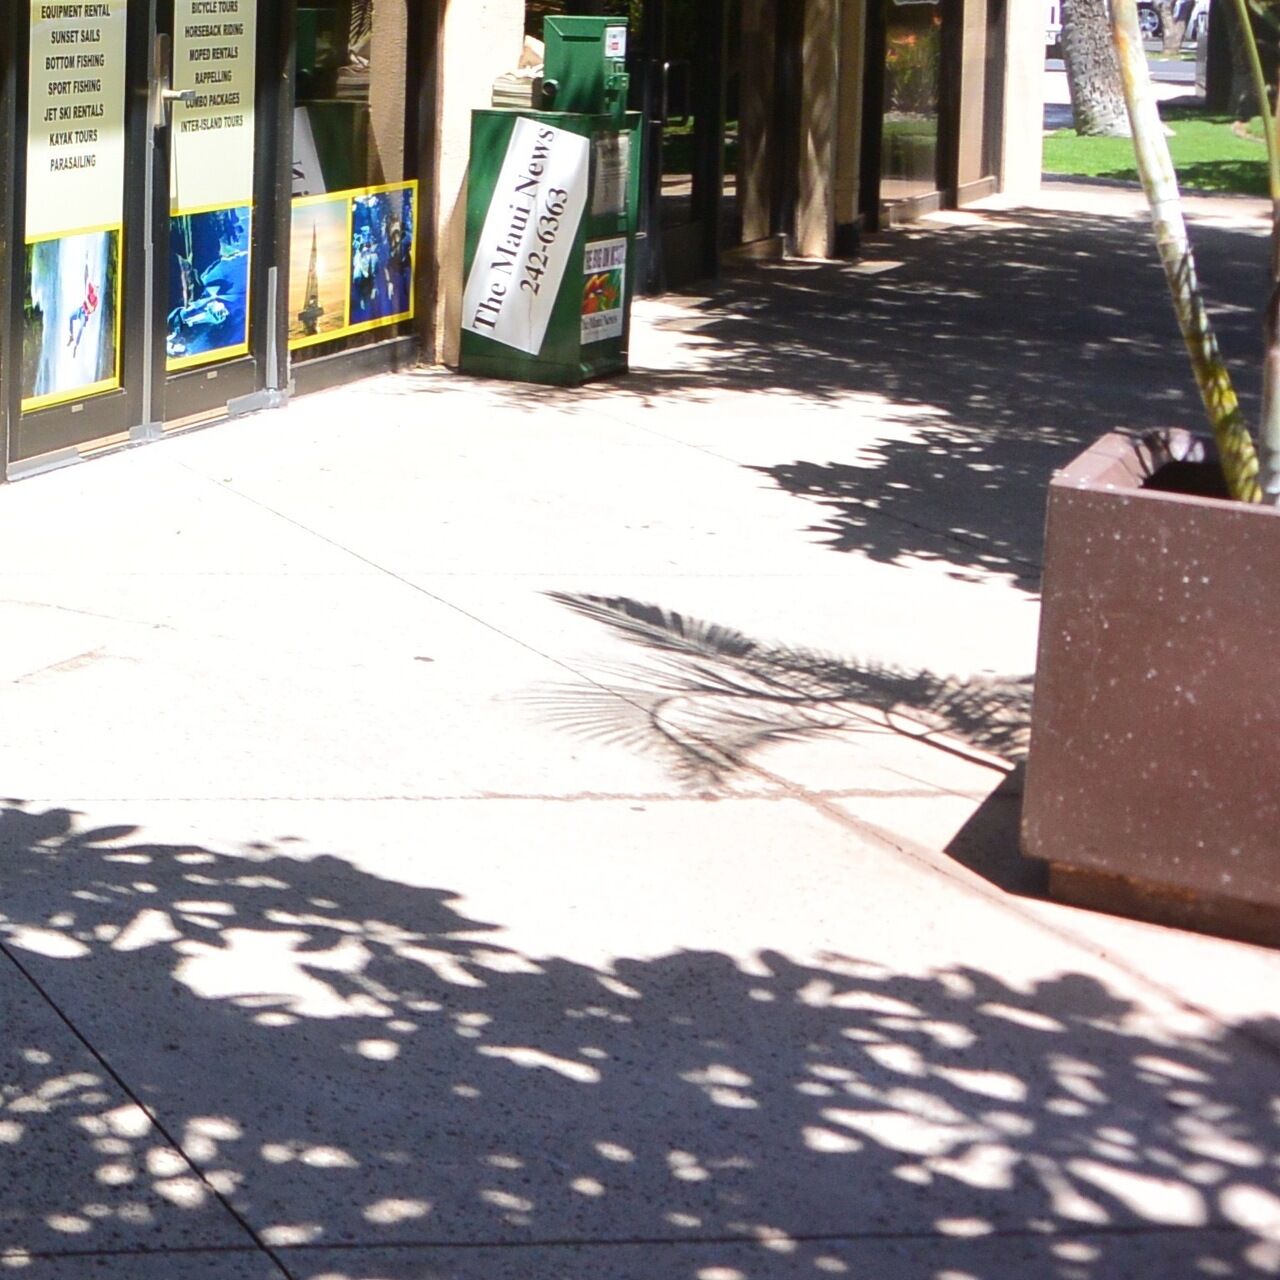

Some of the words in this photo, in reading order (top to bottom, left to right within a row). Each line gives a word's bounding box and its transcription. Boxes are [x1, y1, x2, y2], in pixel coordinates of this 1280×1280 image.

[41, 5, 82, 19] EQUIPMENT
[84, 4, 110, 17] RENTAL
[191, 1, 217, 14] BICYCLE
[218, 0, 238, 13] TOURS
[51, 30, 79, 44] SUNSET
[80, 29, 100, 43] SAILS
[185, 24, 222, 38] HORSEBACK
[223, 23, 244, 36] RIDING
[189, 48, 210, 61] MOPED
[212, 46, 239, 60] RENTALS
[45, 56, 75, 70] BOTTOM
[77, 54, 105, 68] FISHING
[195, 70, 232, 84] RAPPELLING
[48, 81, 72, 95] SPORT
[73, 79, 101, 94] FISHING
[209, 92, 240, 107] PACKAGES
[44, 107, 57, 121] JET
[59, 106, 72, 120] SKI
[73, 104, 104, 118] RENTALS
[181, 116, 223, 133] INTER-ISLAND
[224, 115, 244, 128] TOURS
[49, 131, 73, 146] KAYAK
[75, 129, 98, 143] TOURS
[50, 154, 96, 172] PARASAILING
[472, 282, 507, 330] The
[490, 204, 532, 276] Maui
[514, 127, 555, 198] News
[519, 187, 569, 297] 242-6363
